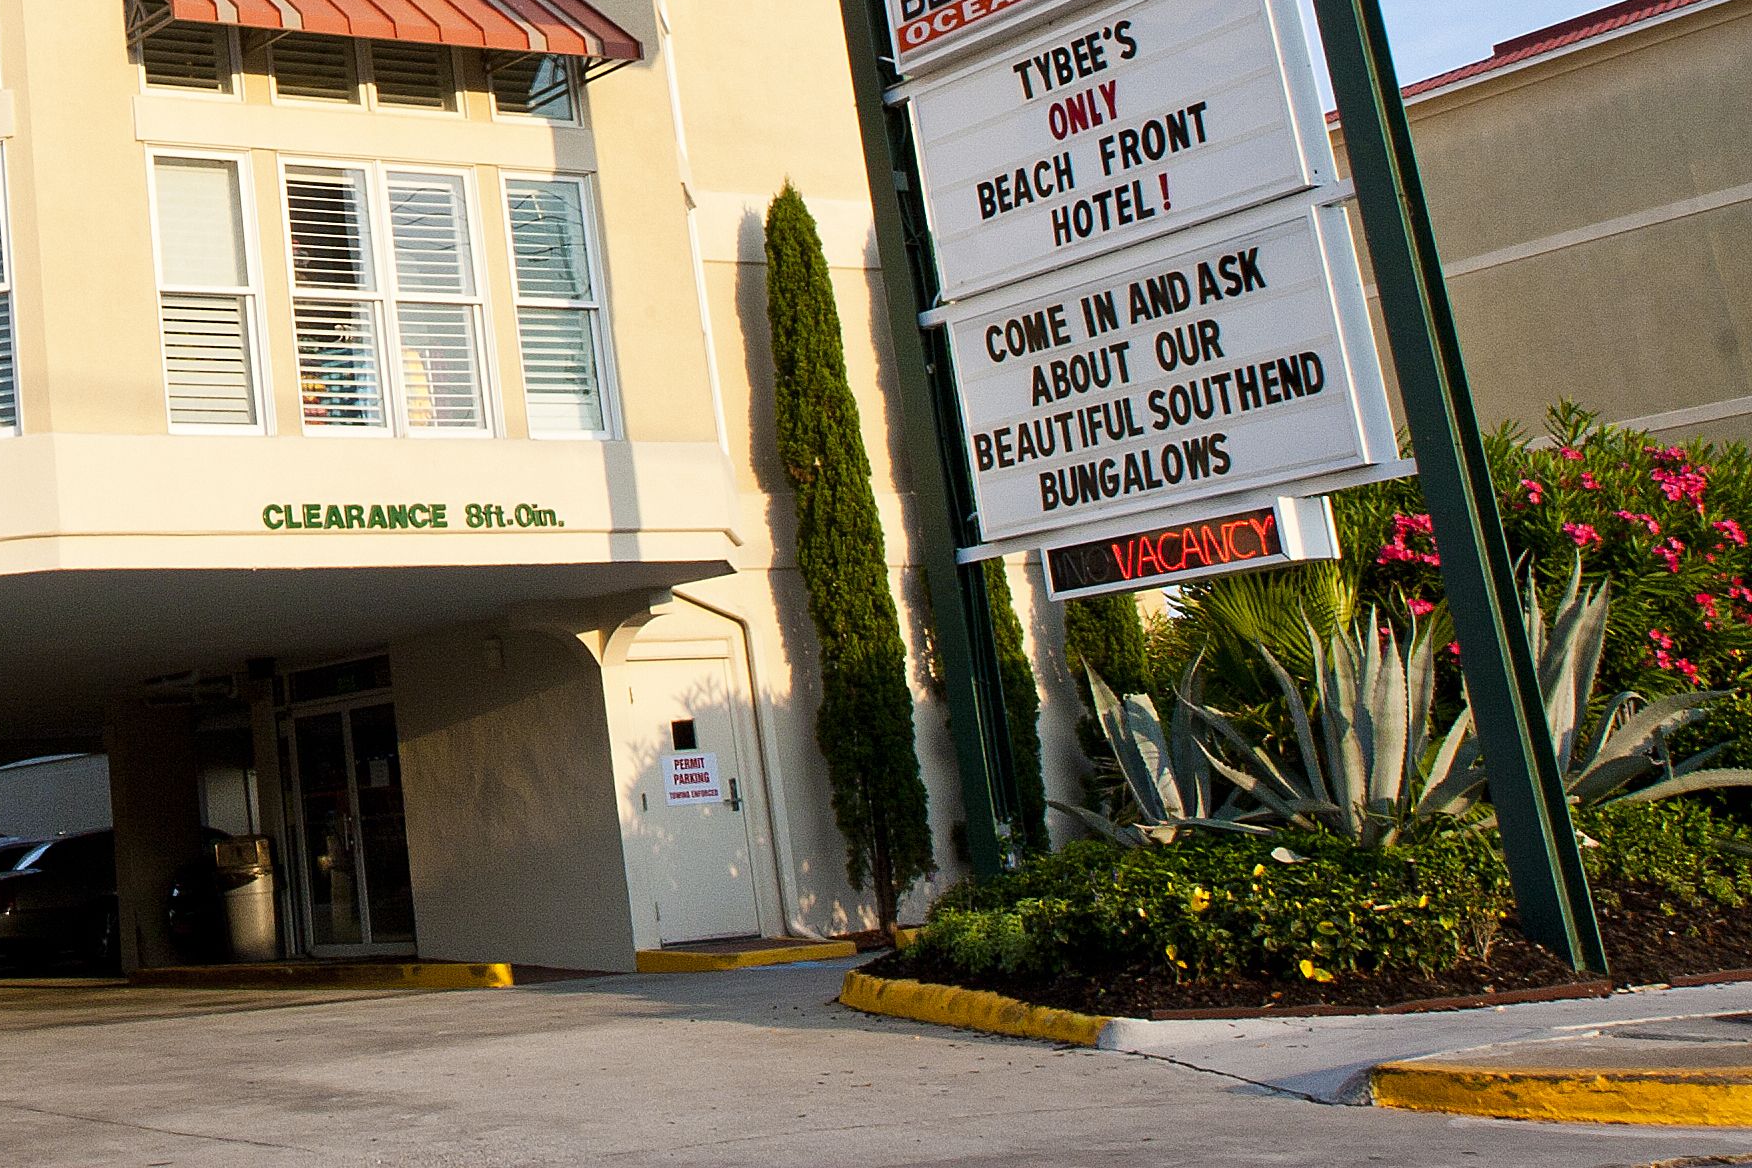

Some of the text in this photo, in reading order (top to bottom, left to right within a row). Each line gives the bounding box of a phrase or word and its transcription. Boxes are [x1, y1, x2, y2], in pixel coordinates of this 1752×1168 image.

[1013, 20, 1138, 101] TYBEE'S
[1048, 80, 1118, 140] ONLY
[976, 101, 1208, 220] BEACH FRONT
[985, 246, 1266, 363] COME IN AND ASK
[1031, 319, 1224, 407] ABOUT OUR
[974, 350, 1325, 472] BEAUTIFUL SOUTHEND
[1040, 432, 1232, 512] BUNGALOWS
[262, 503, 449, 530] CLEARANCE
[1111, 514, 1274, 581] VACANCY
[673, 757, 705, 770] PERMIT
[673, 772, 710, 785] PARKING
